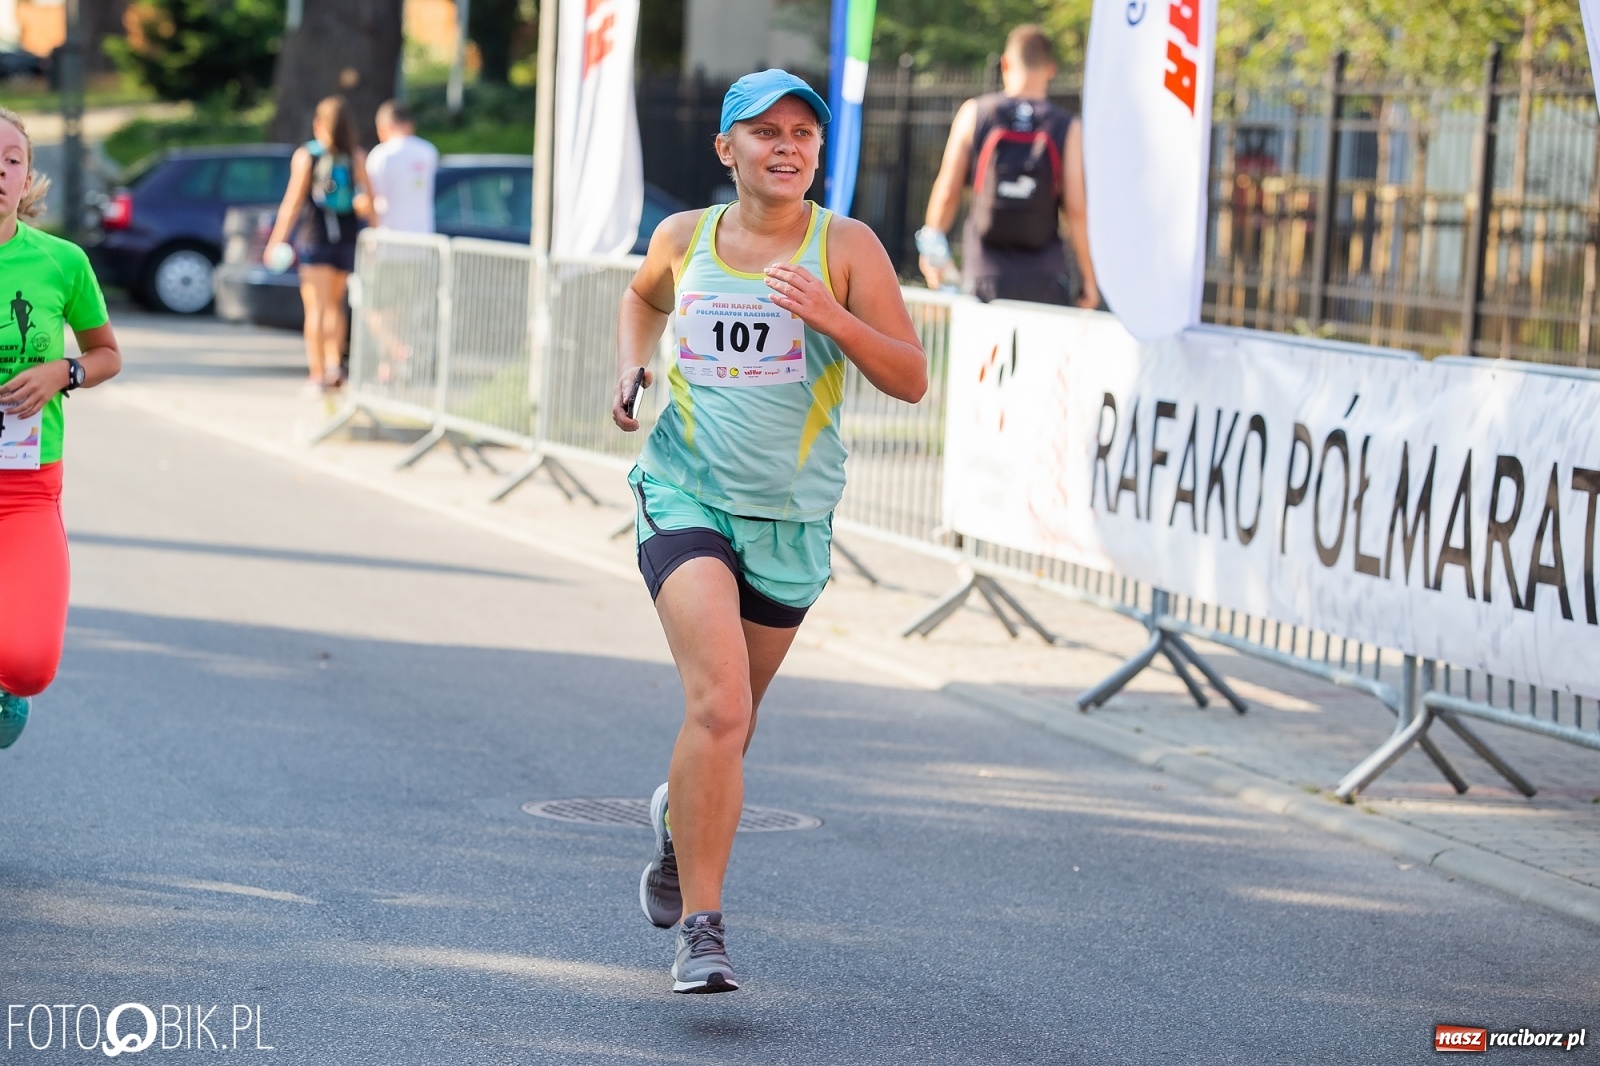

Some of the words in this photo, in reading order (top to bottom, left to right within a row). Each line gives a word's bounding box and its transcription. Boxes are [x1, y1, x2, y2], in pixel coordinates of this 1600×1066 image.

[711, 302, 729, 310] MINI
[731, 303, 763, 311] RAFAKO
[712, 320, 770, 353] 107
[1091, 391, 1268, 546] RAFAKO
[1279, 394, 1600, 625] PÓŁMARAT
